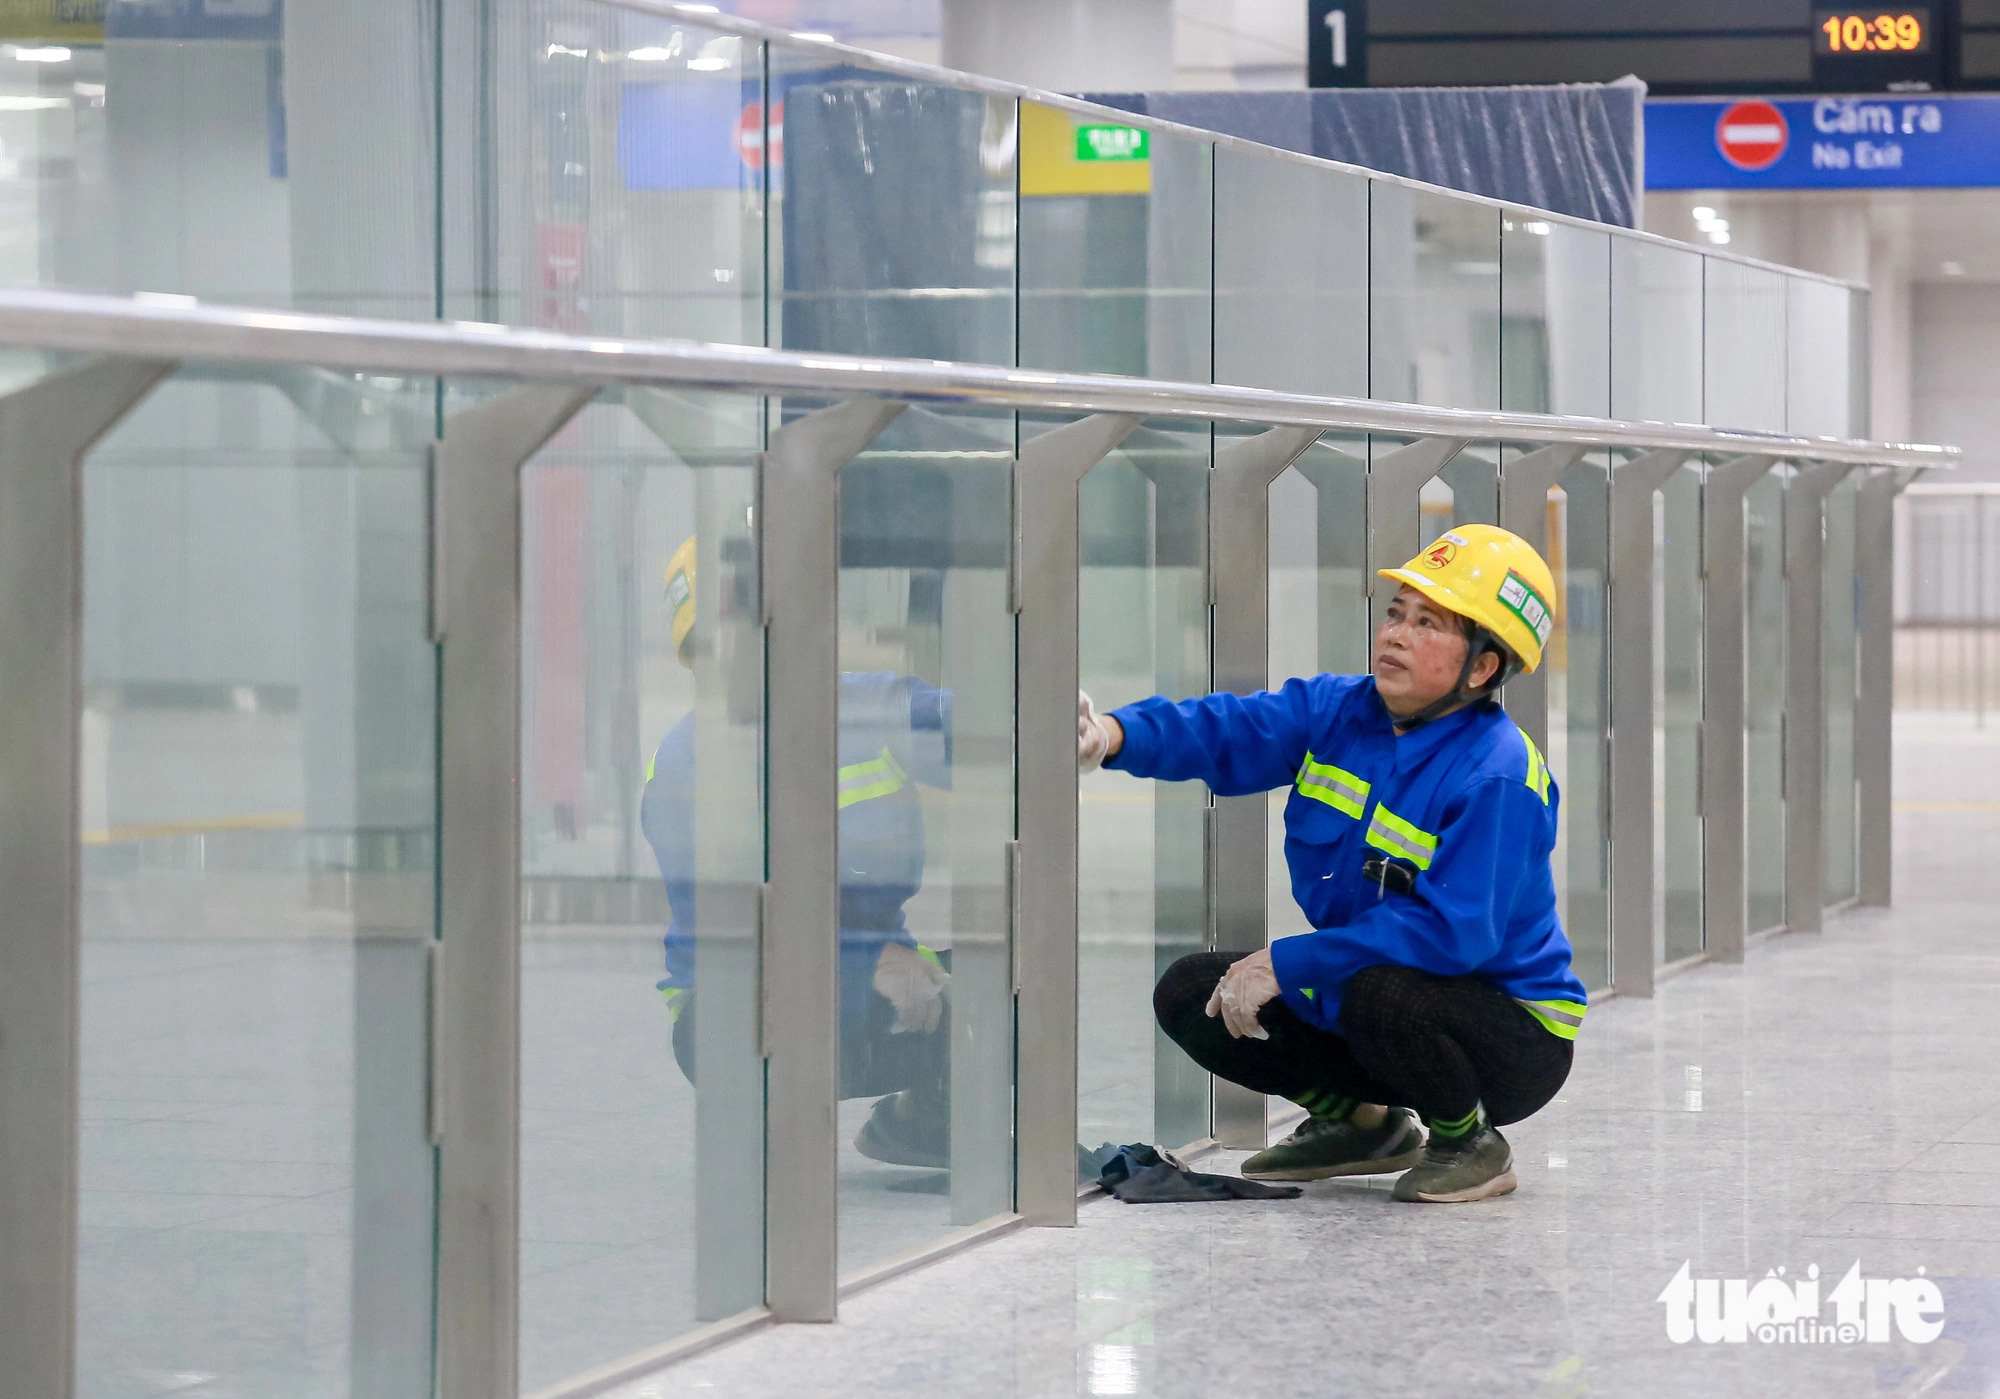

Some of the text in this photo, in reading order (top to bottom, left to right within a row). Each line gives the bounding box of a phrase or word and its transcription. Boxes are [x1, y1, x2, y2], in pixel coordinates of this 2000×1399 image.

[1327, 9, 1347, 66] 1
[1818, 11, 1921, 52] 10:39
[1902, 105, 1942, 135] ra
[1812, 141, 1902, 169] No Exit
